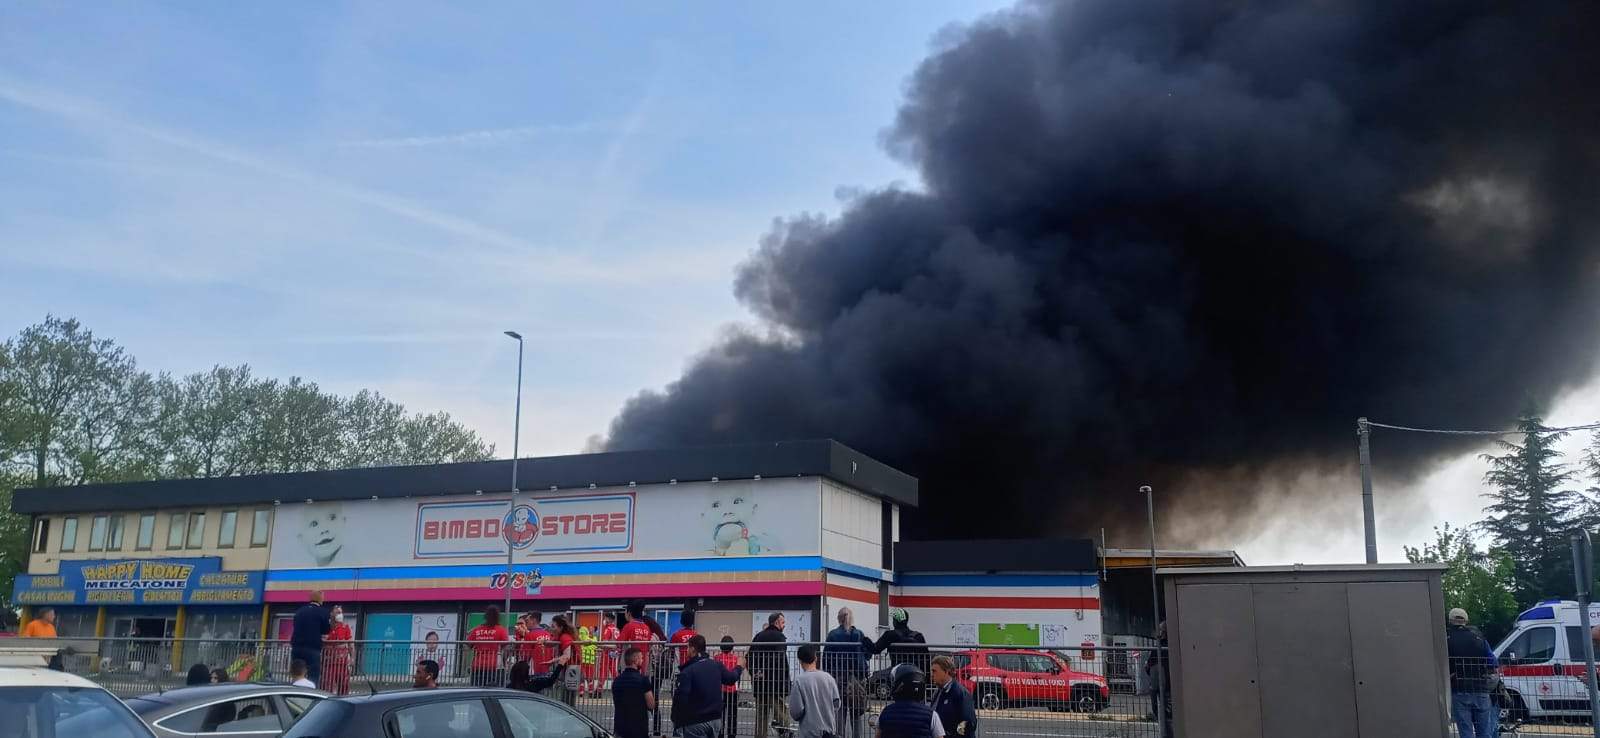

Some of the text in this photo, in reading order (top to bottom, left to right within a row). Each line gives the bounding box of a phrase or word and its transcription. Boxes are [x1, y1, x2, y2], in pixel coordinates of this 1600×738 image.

[423, 512, 627, 540] BIMBO STORE
[83, 559, 194, 581] HAPPY HOME
[86, 580, 186, 589] MERCATONE
